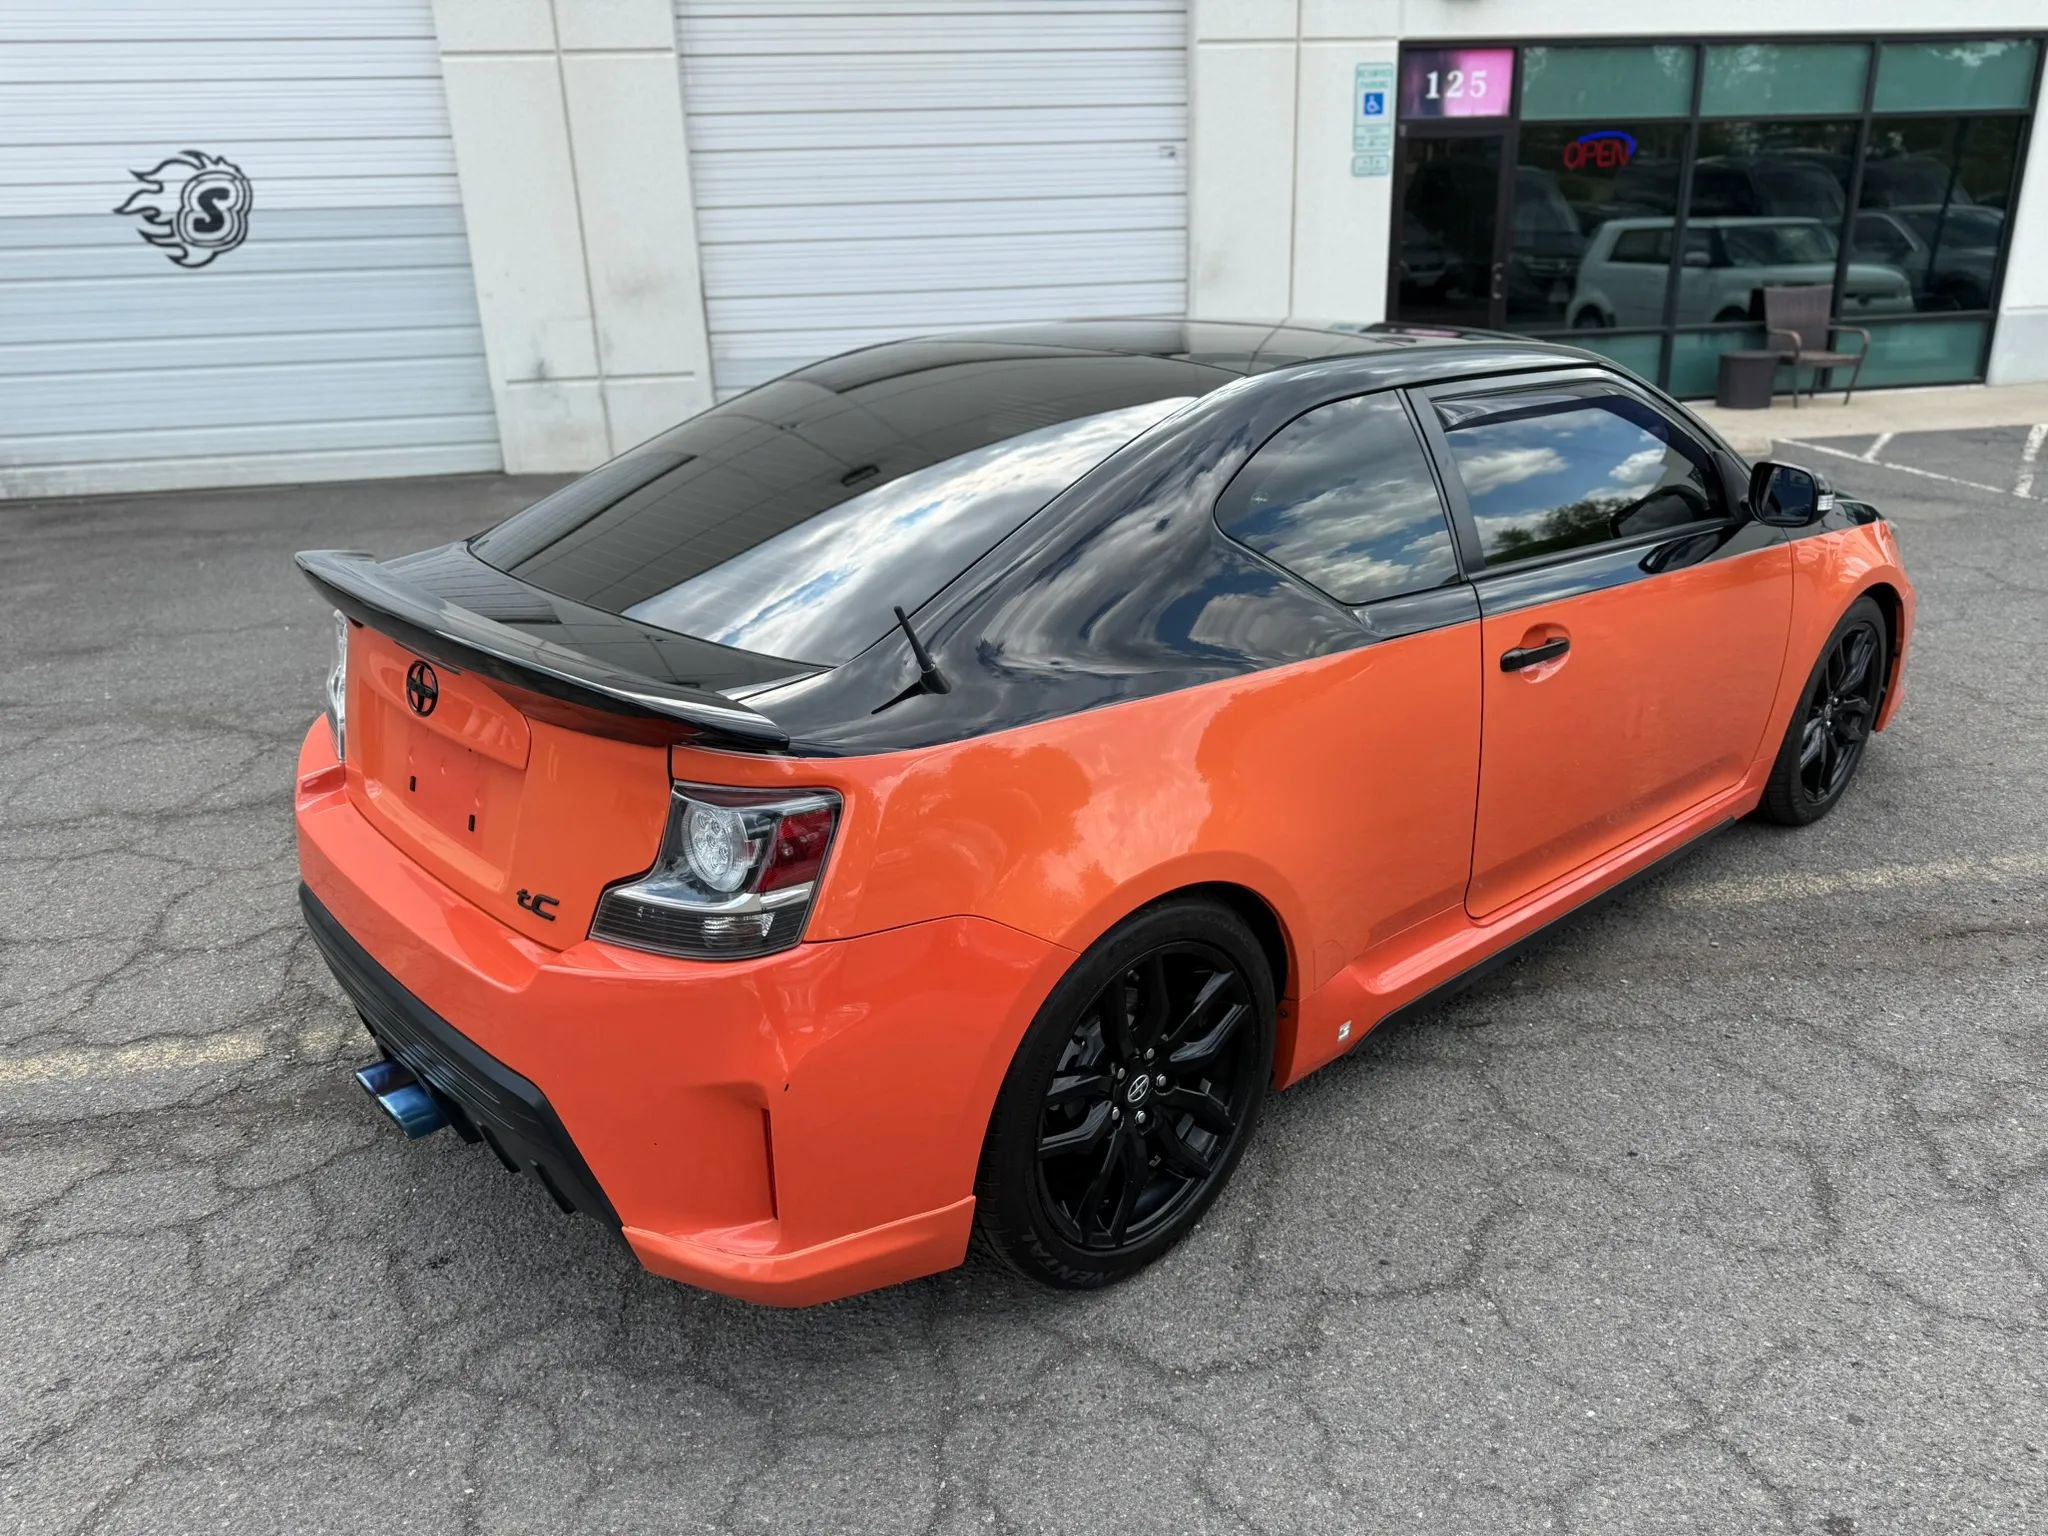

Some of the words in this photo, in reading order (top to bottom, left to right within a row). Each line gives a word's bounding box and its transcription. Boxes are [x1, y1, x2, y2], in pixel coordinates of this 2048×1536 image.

[1425, 69, 1488, 99] 125
[1562, 140, 1630, 170] OPEN
[190, 184, 234, 237] S
